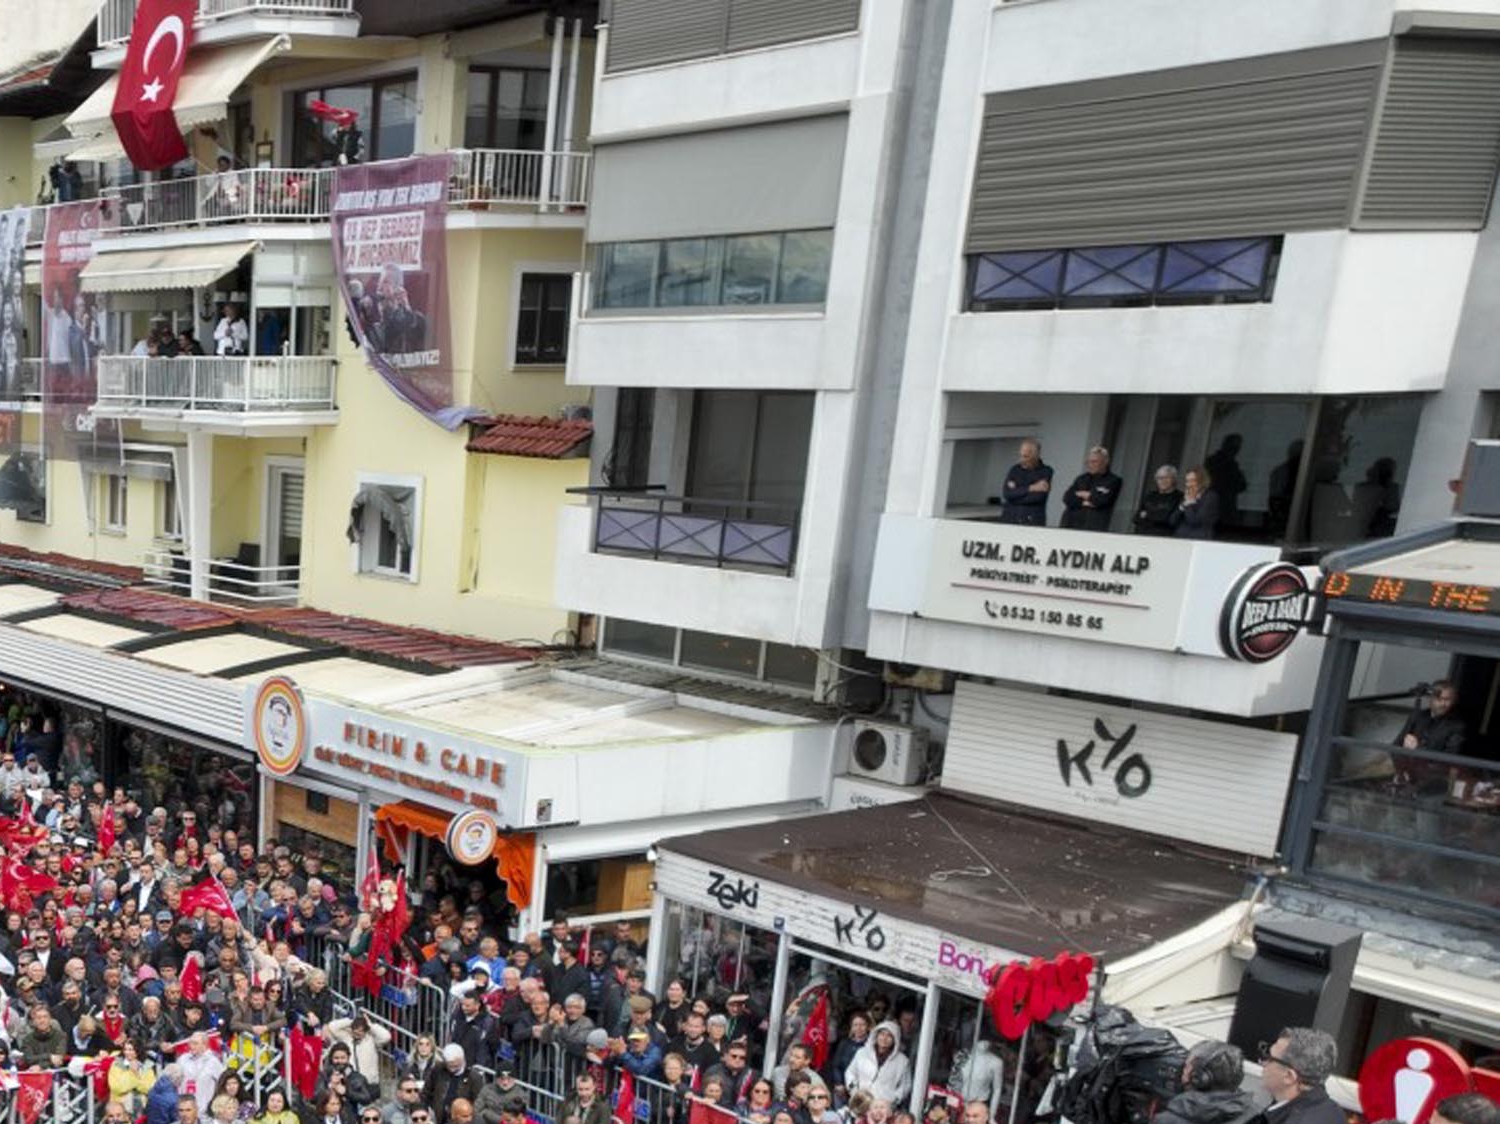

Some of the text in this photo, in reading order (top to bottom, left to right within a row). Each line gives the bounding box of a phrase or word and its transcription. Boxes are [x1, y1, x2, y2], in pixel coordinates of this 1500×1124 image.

[962, 540, 1150, 575] UZM. DR. AYDIN ALP
[1368, 576, 1405, 603] IN
[1429, 581, 1494, 612] THE
[414, 741, 426, 763] &
[440, 748, 504, 787] CAFE
[1057, 717, 1152, 798] KYO
[707, 870, 760, 910] Zeki
